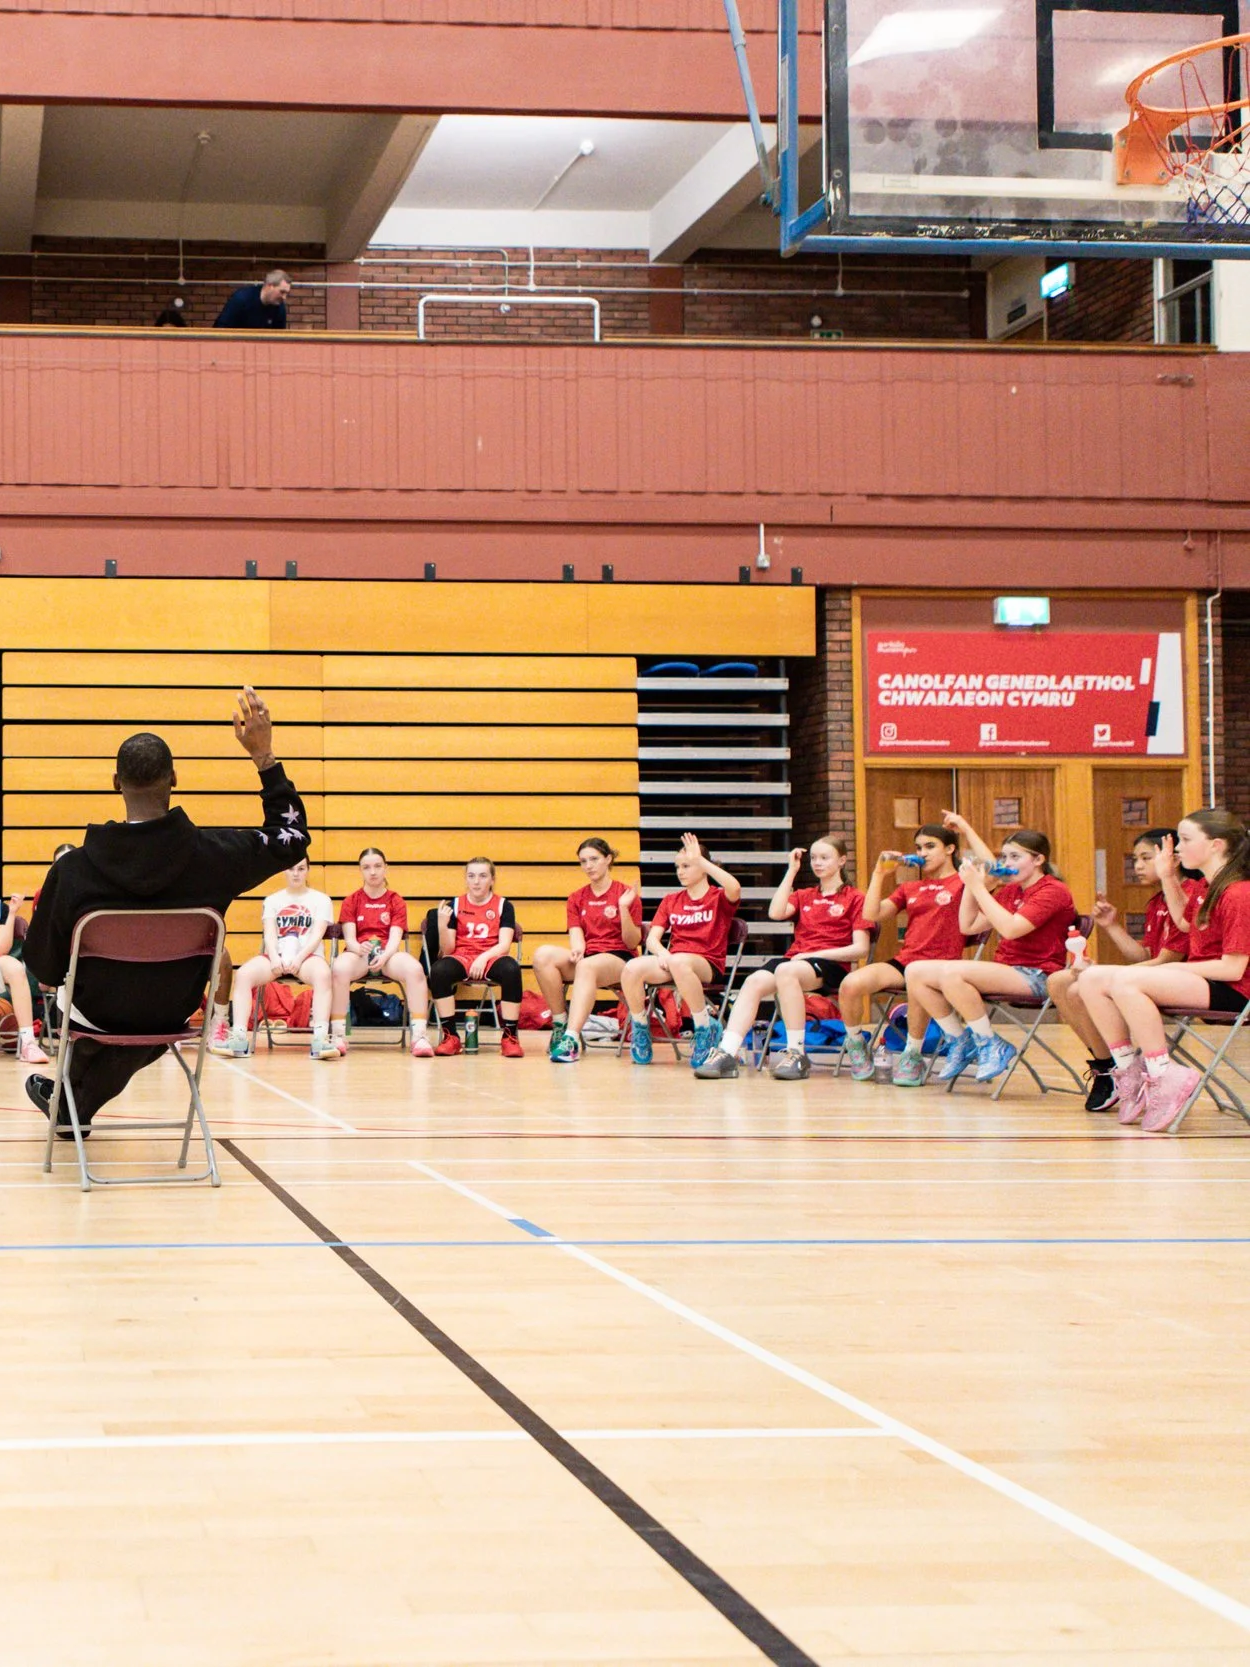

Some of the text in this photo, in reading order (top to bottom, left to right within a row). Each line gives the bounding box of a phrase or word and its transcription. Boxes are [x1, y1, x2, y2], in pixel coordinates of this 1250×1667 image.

[878, 674, 1135, 691] CANOLFAN GENEDLAETHOL
[878, 690, 1077, 707] CHWARAEON CYMRU
[276, 915, 312, 928] CYMRU
[669, 910, 713, 925] CYMRU
[466, 922, 490, 939] 12
